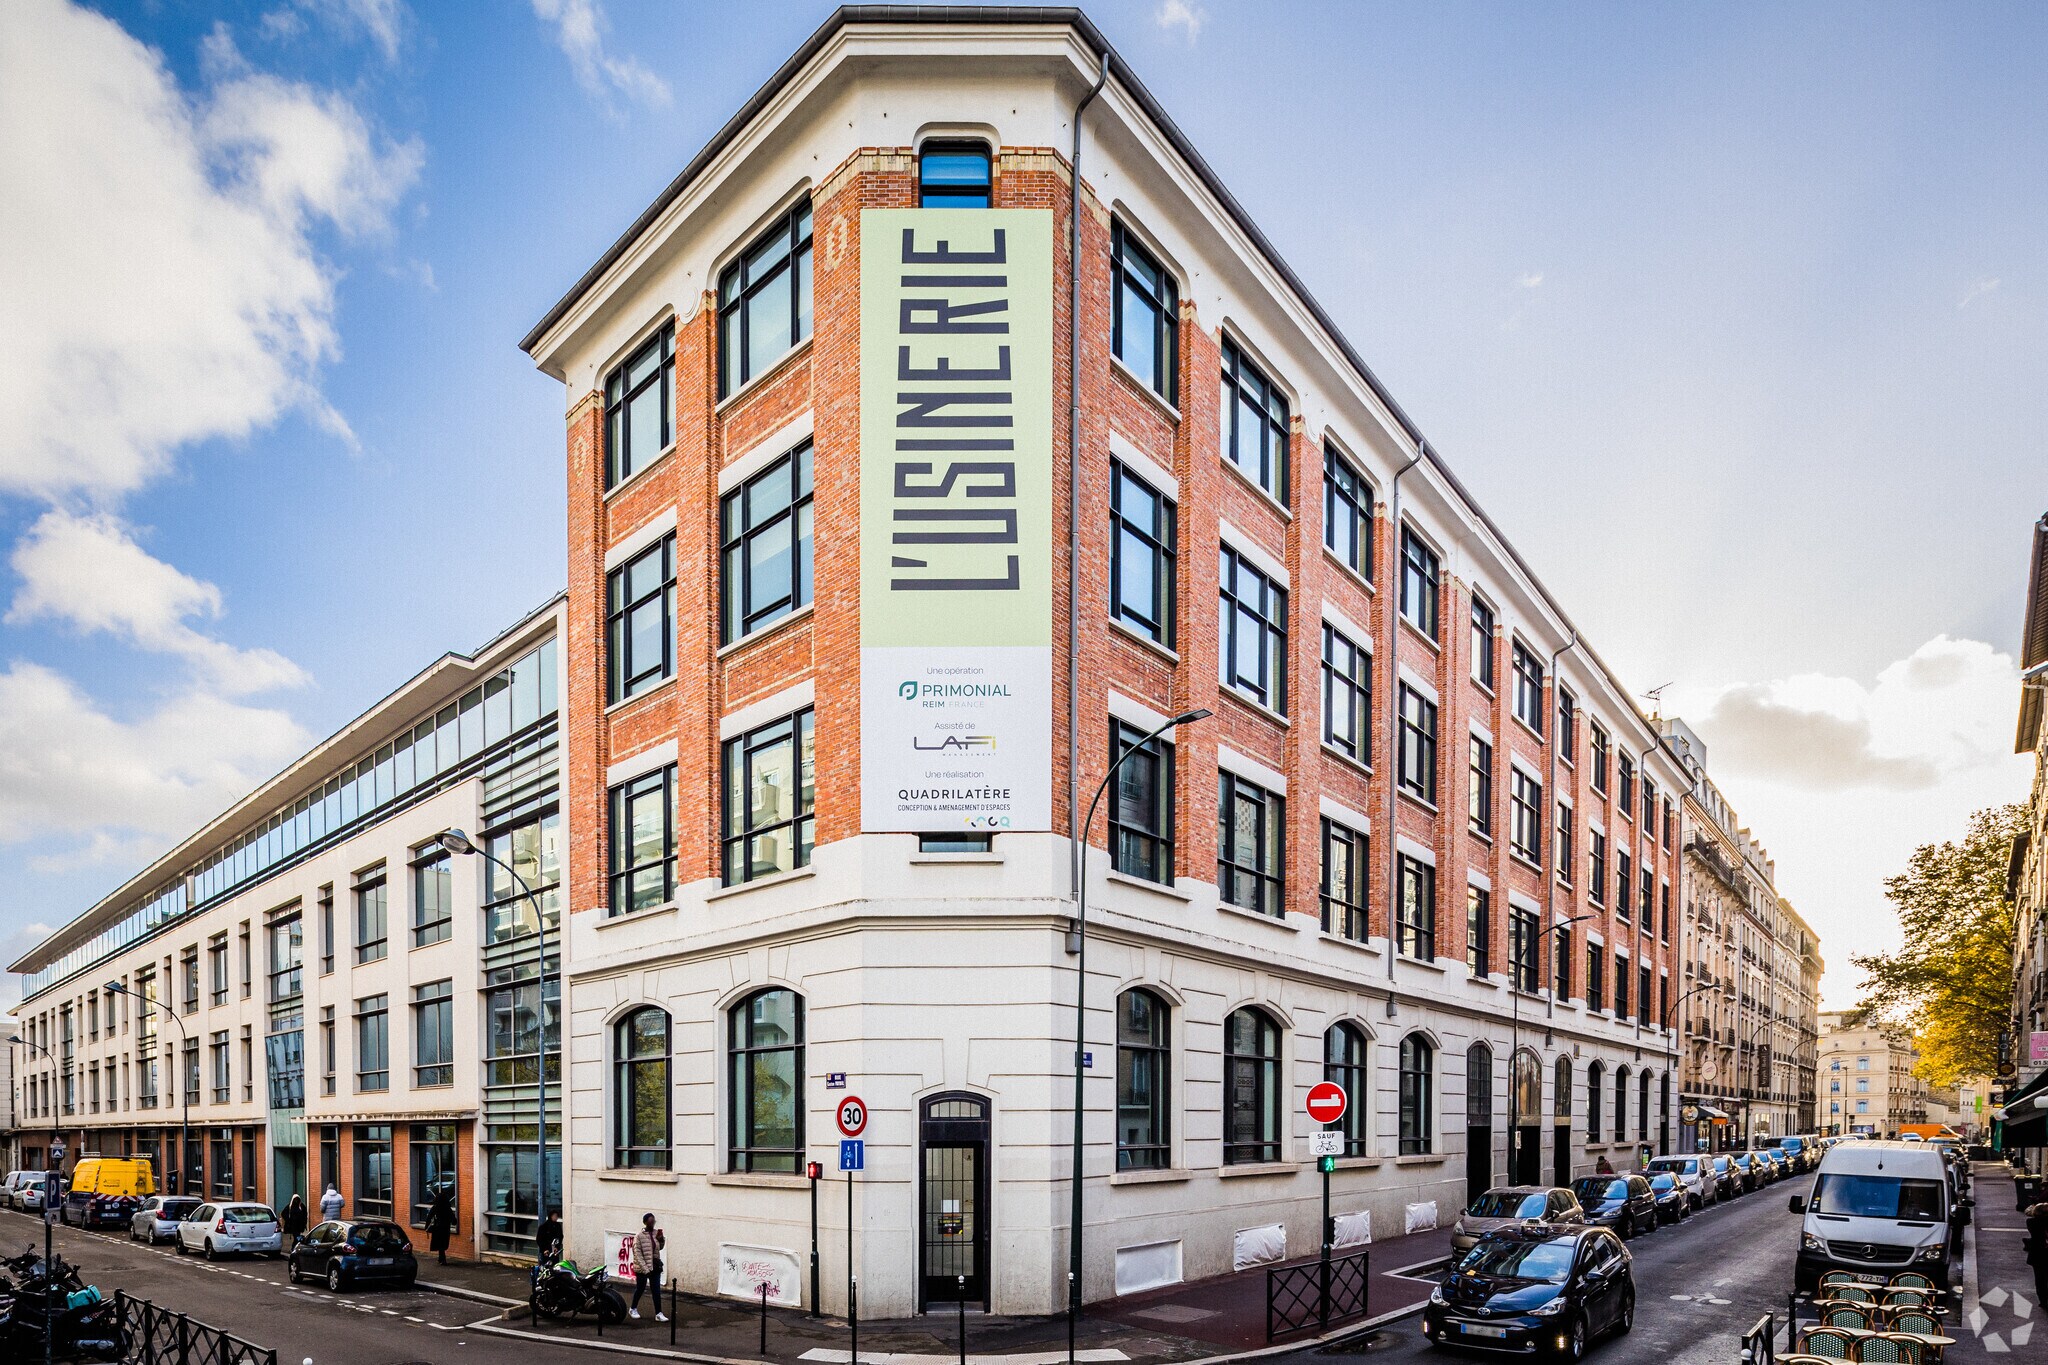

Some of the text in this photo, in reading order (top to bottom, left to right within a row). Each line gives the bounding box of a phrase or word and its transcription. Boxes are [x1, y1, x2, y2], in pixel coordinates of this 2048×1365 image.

[890, 228, 1020, 590] L'USINERIE
[926, 667, 984, 676] Une opération
[922, 684, 1012, 697] PRIMONIAL
[934, 722, 976, 730] Assisté de
[925, 770, 985, 779] Une réalisation
[898, 785, 1011, 801] QUADRILATÈRE
[897, 804, 933, 812] CONCEPTION
[938, 804, 980, 812] AMENAGEMENT
[980, 803, 1011, 811] D'ESPACES
[843, 1107, 861, 1125] 30
[50, 1179, 57, 1203] P
